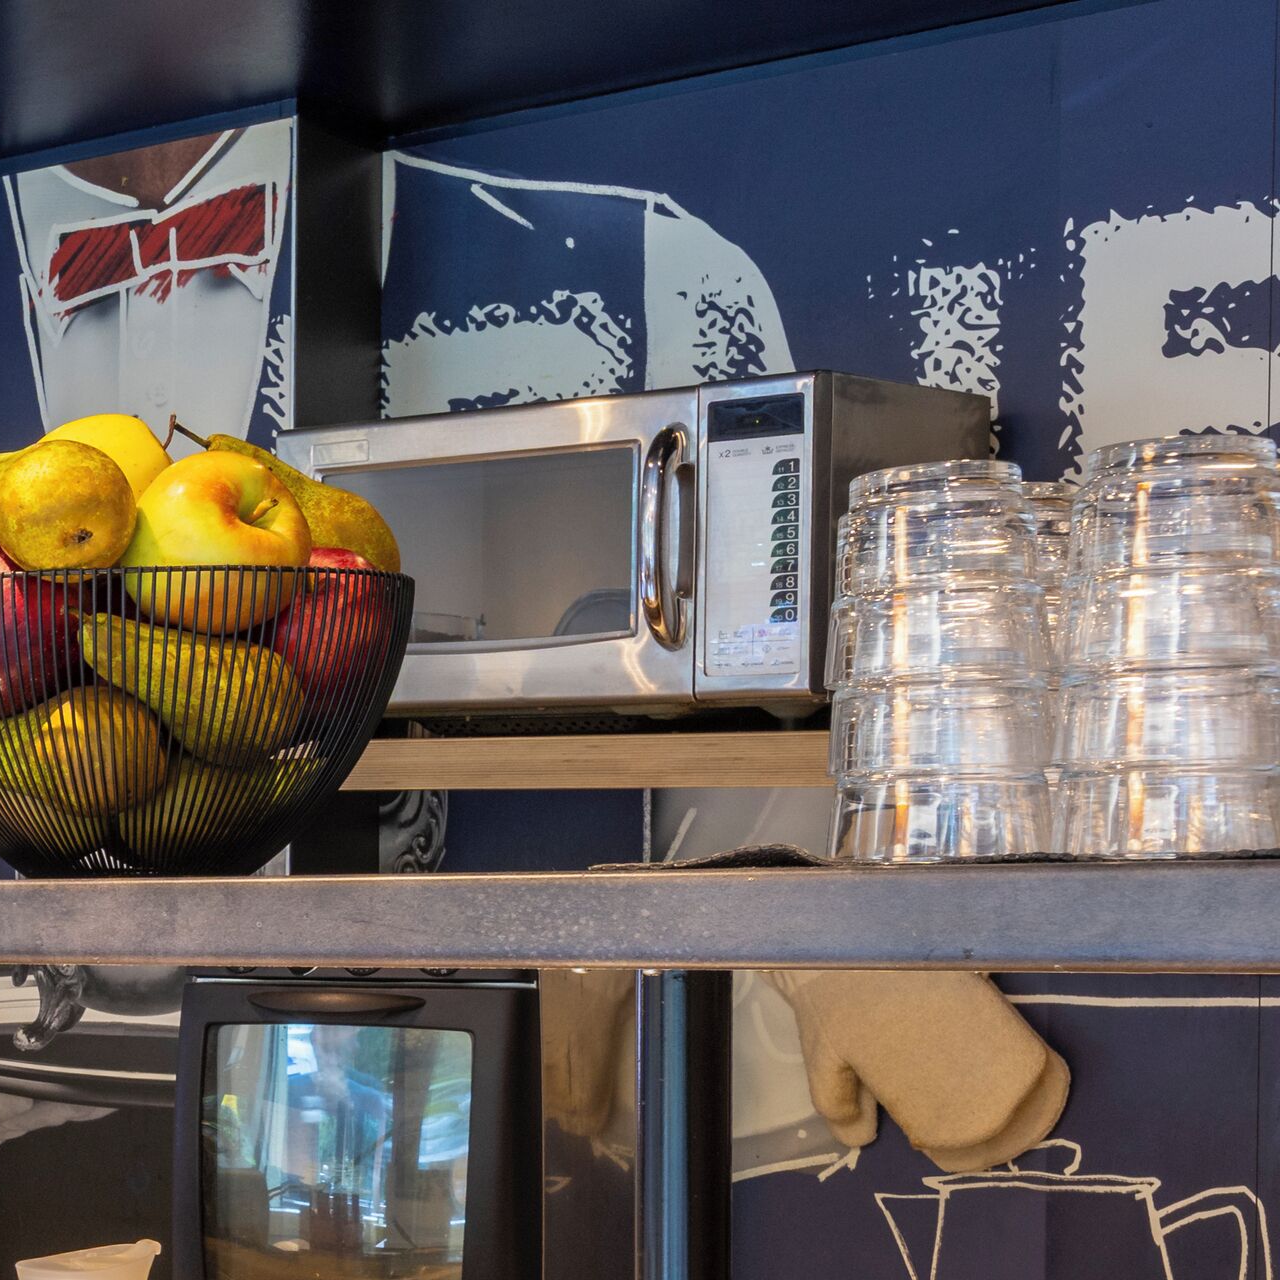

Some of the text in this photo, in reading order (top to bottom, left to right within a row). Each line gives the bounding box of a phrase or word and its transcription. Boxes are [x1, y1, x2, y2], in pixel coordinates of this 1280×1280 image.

[789, 461, 794, 472] 1
[787, 477, 796, 488] 2
[787, 493, 796, 505] 3
[787, 510, 795, 522] 4
[786, 526, 795, 538] 5
[786, 543, 795, 555] 6
[786, 559, 795, 571] 7
[785, 575, 795, 588] 8
[785, 592, 794, 604] 9
[785, 608, 794, 621] 0
